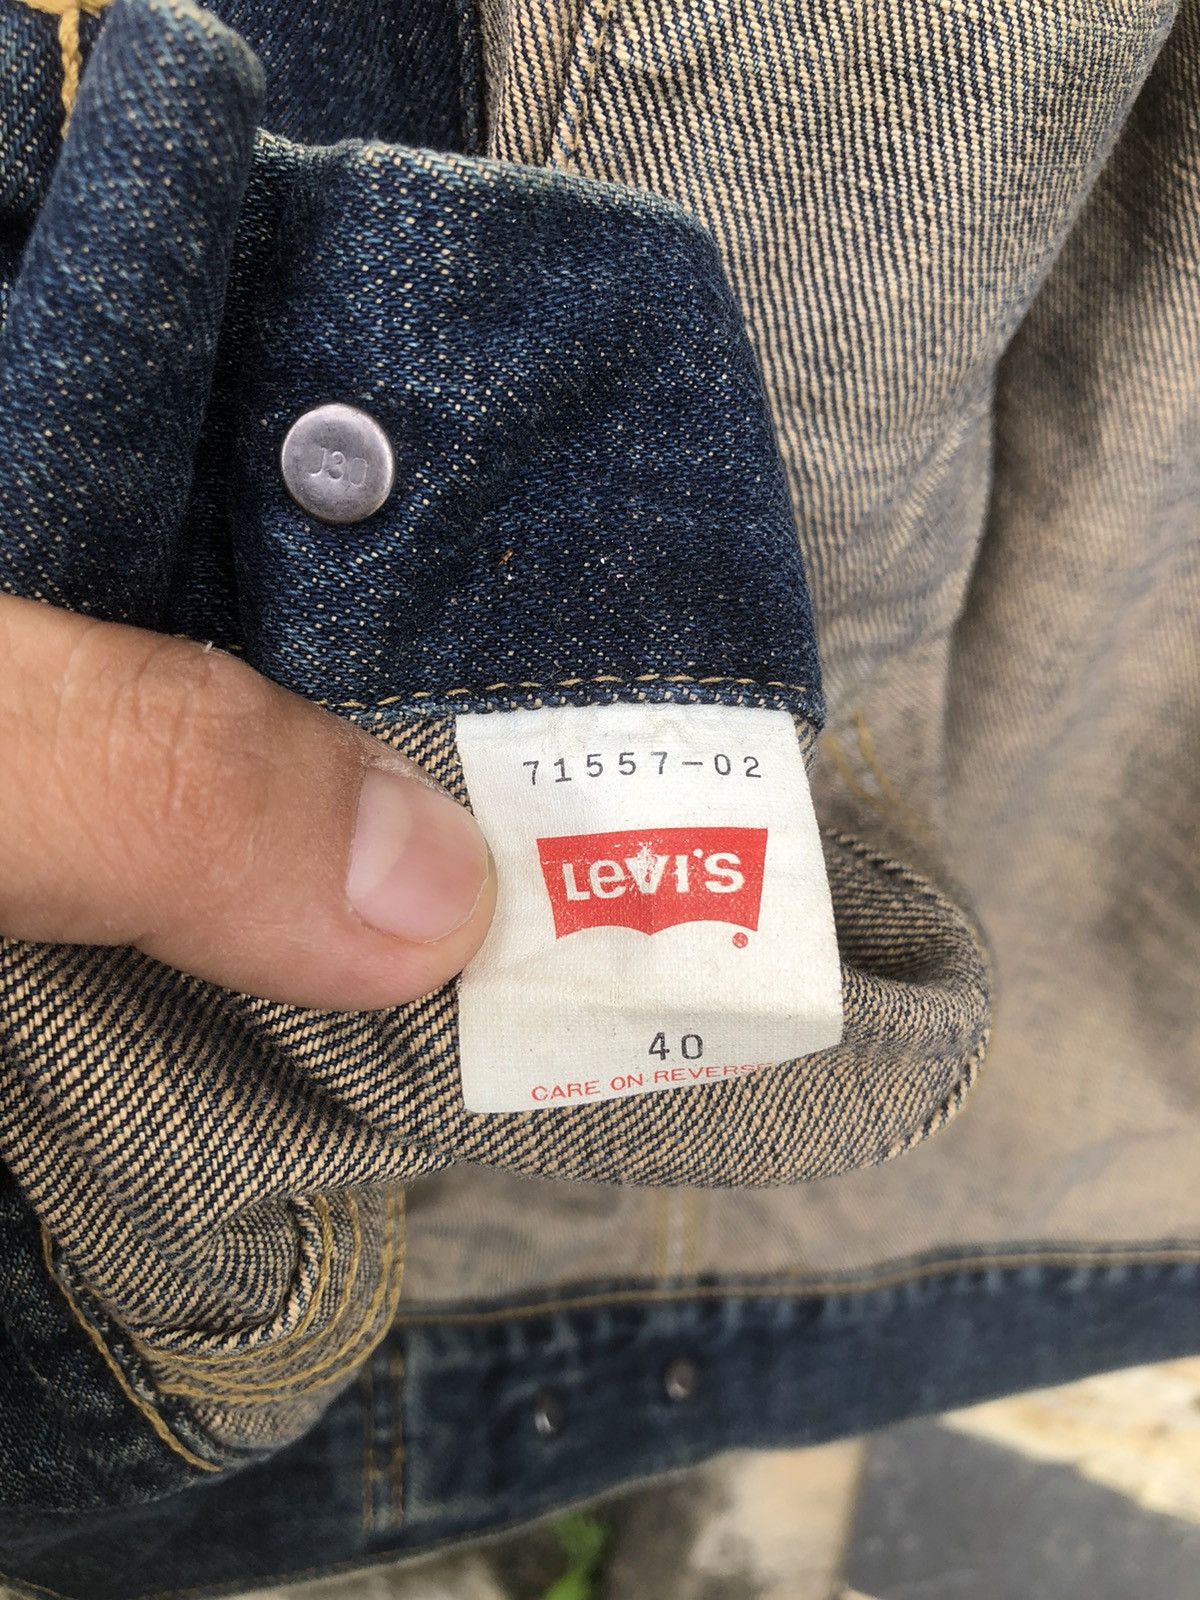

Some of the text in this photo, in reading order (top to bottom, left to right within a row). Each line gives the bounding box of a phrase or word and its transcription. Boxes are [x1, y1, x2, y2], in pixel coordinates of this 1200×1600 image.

[522, 751, 763, 786] 71557-02
[648, 1032, 704, 1061] 40
[530, 1079, 601, 1102] CARE
[609, 1072, 644, 1091] ON
